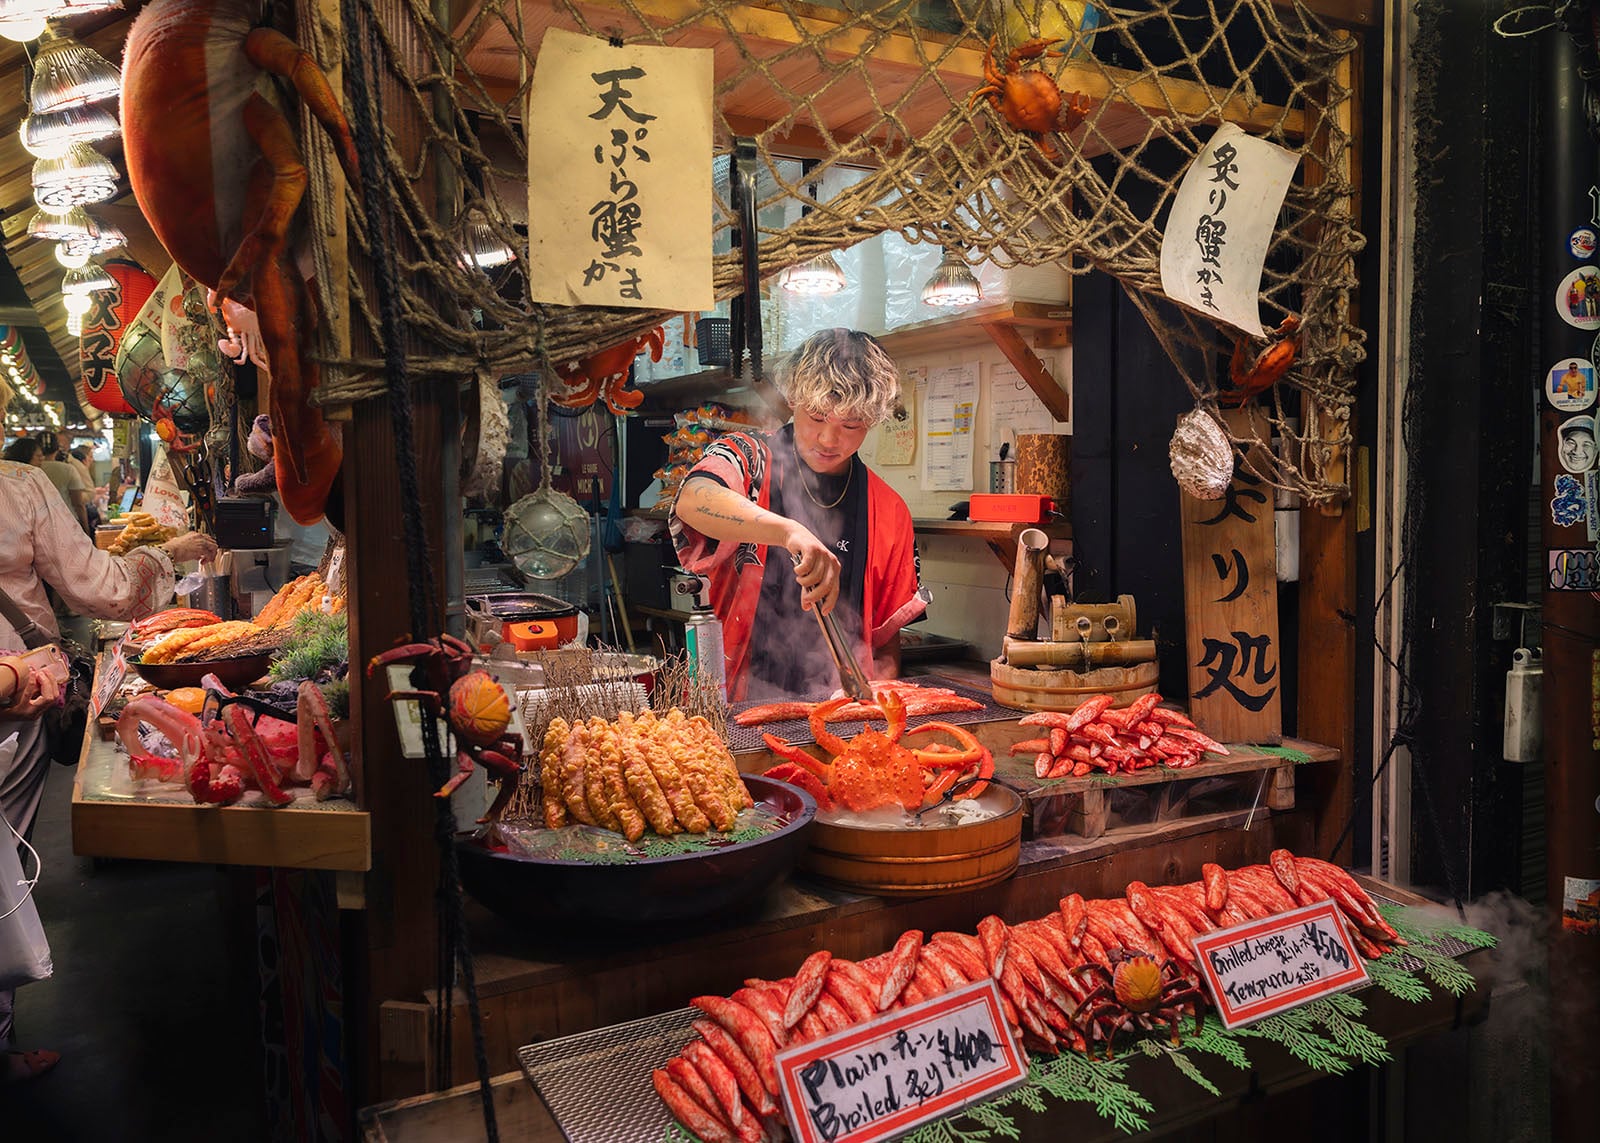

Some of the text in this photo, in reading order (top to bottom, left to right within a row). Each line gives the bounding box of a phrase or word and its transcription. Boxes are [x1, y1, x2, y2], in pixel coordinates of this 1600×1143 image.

[583, 66, 657, 300] 天ぷら蟹かま
[154, 487, 180, 501] Love
[1256, 934, 1288, 956] cheese
[1225, 970, 1295, 1004] Tempura
[800, 1051, 888, 1105] Plain
